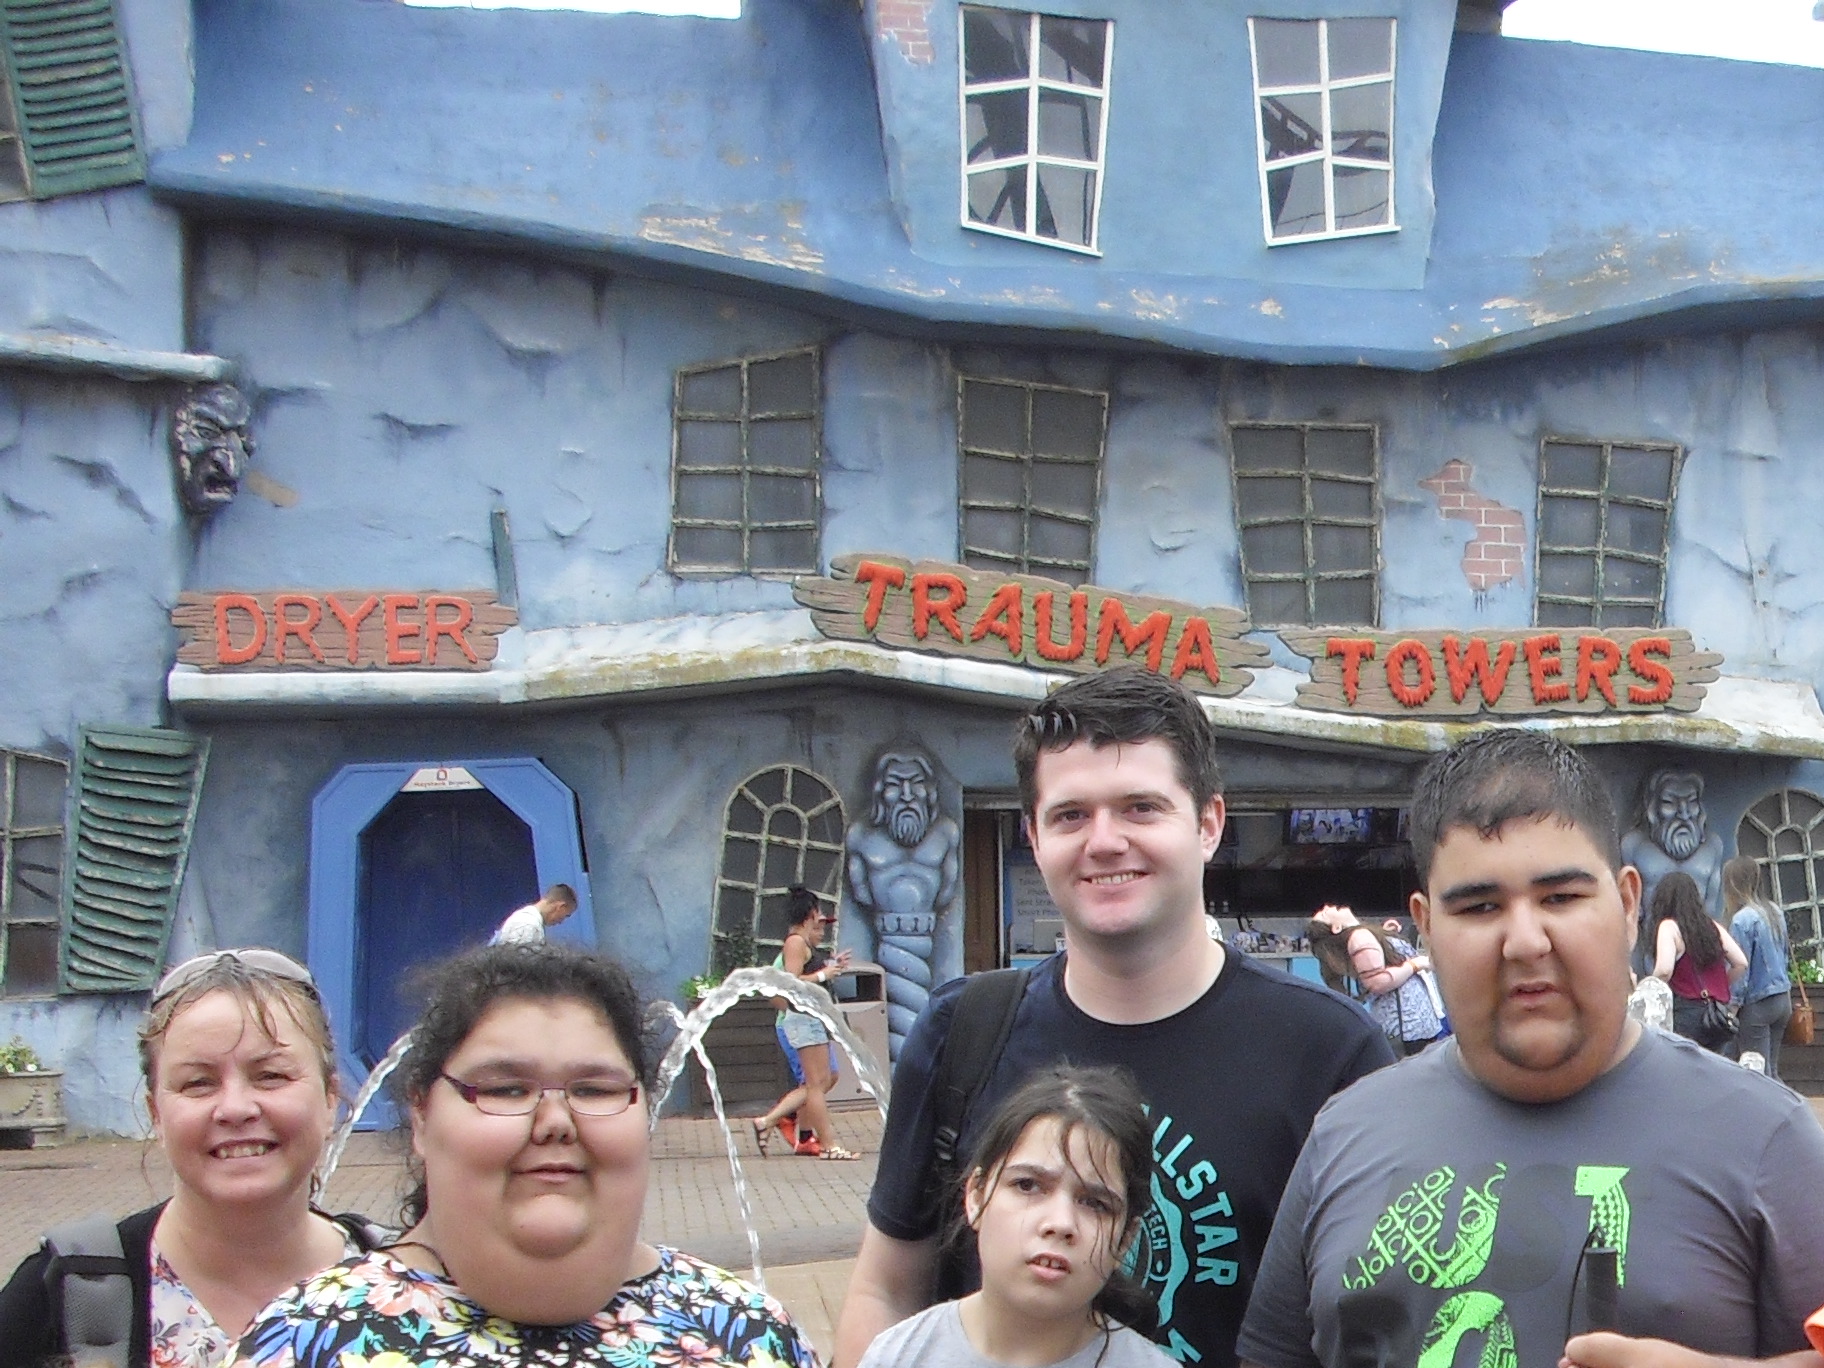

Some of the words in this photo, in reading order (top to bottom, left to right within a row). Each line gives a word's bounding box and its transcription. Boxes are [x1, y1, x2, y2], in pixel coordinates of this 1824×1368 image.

[213, 594, 479, 665] DRYER
[855, 560, 1221, 687] TRAUMA
[1325, 633, 1675, 708] TOWERS
[1140, 1103, 1240, 1287] LLSTAR
